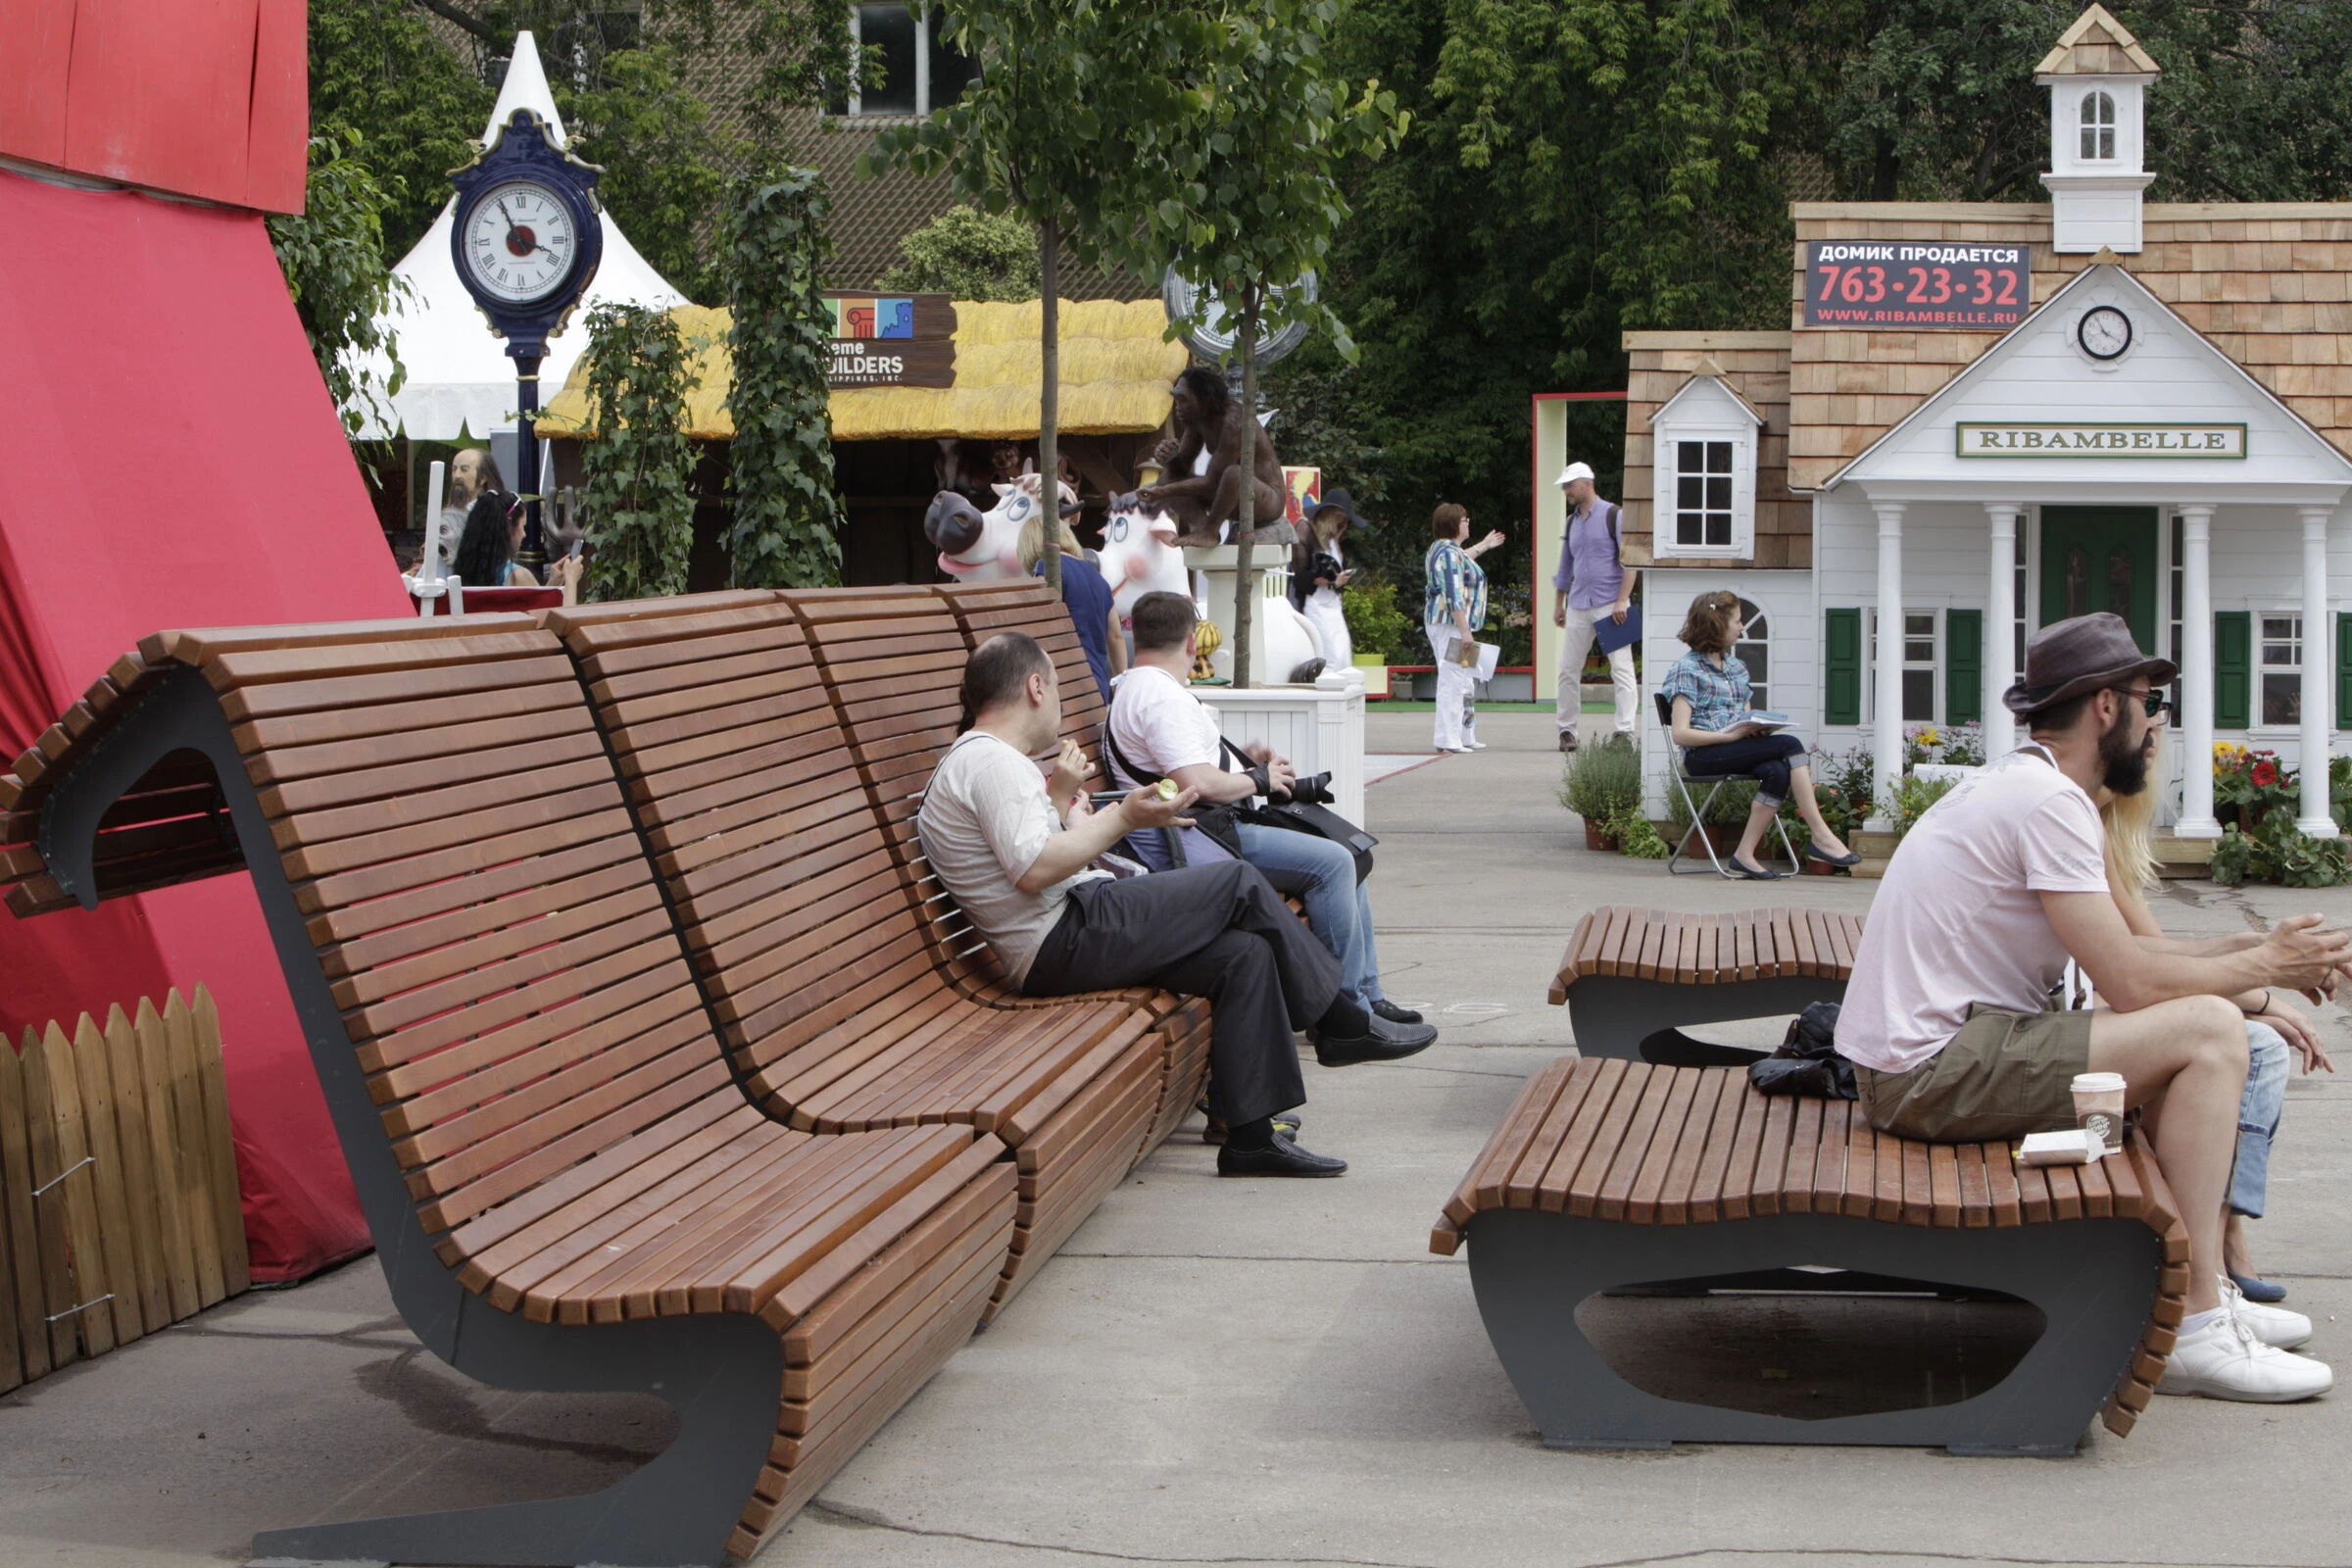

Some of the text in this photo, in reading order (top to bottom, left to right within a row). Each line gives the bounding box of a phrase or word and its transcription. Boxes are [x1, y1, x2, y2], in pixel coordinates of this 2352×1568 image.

[1819, 246, 2019, 264] ДОМИК ПРОДАЕТСЯ
[1817, 309, 2018, 323] WWW.RIBAMBELLE.RU
[816, 356, 904, 374] UILDERS
[1980, 431, 2227, 450] RIBAMBELLE
